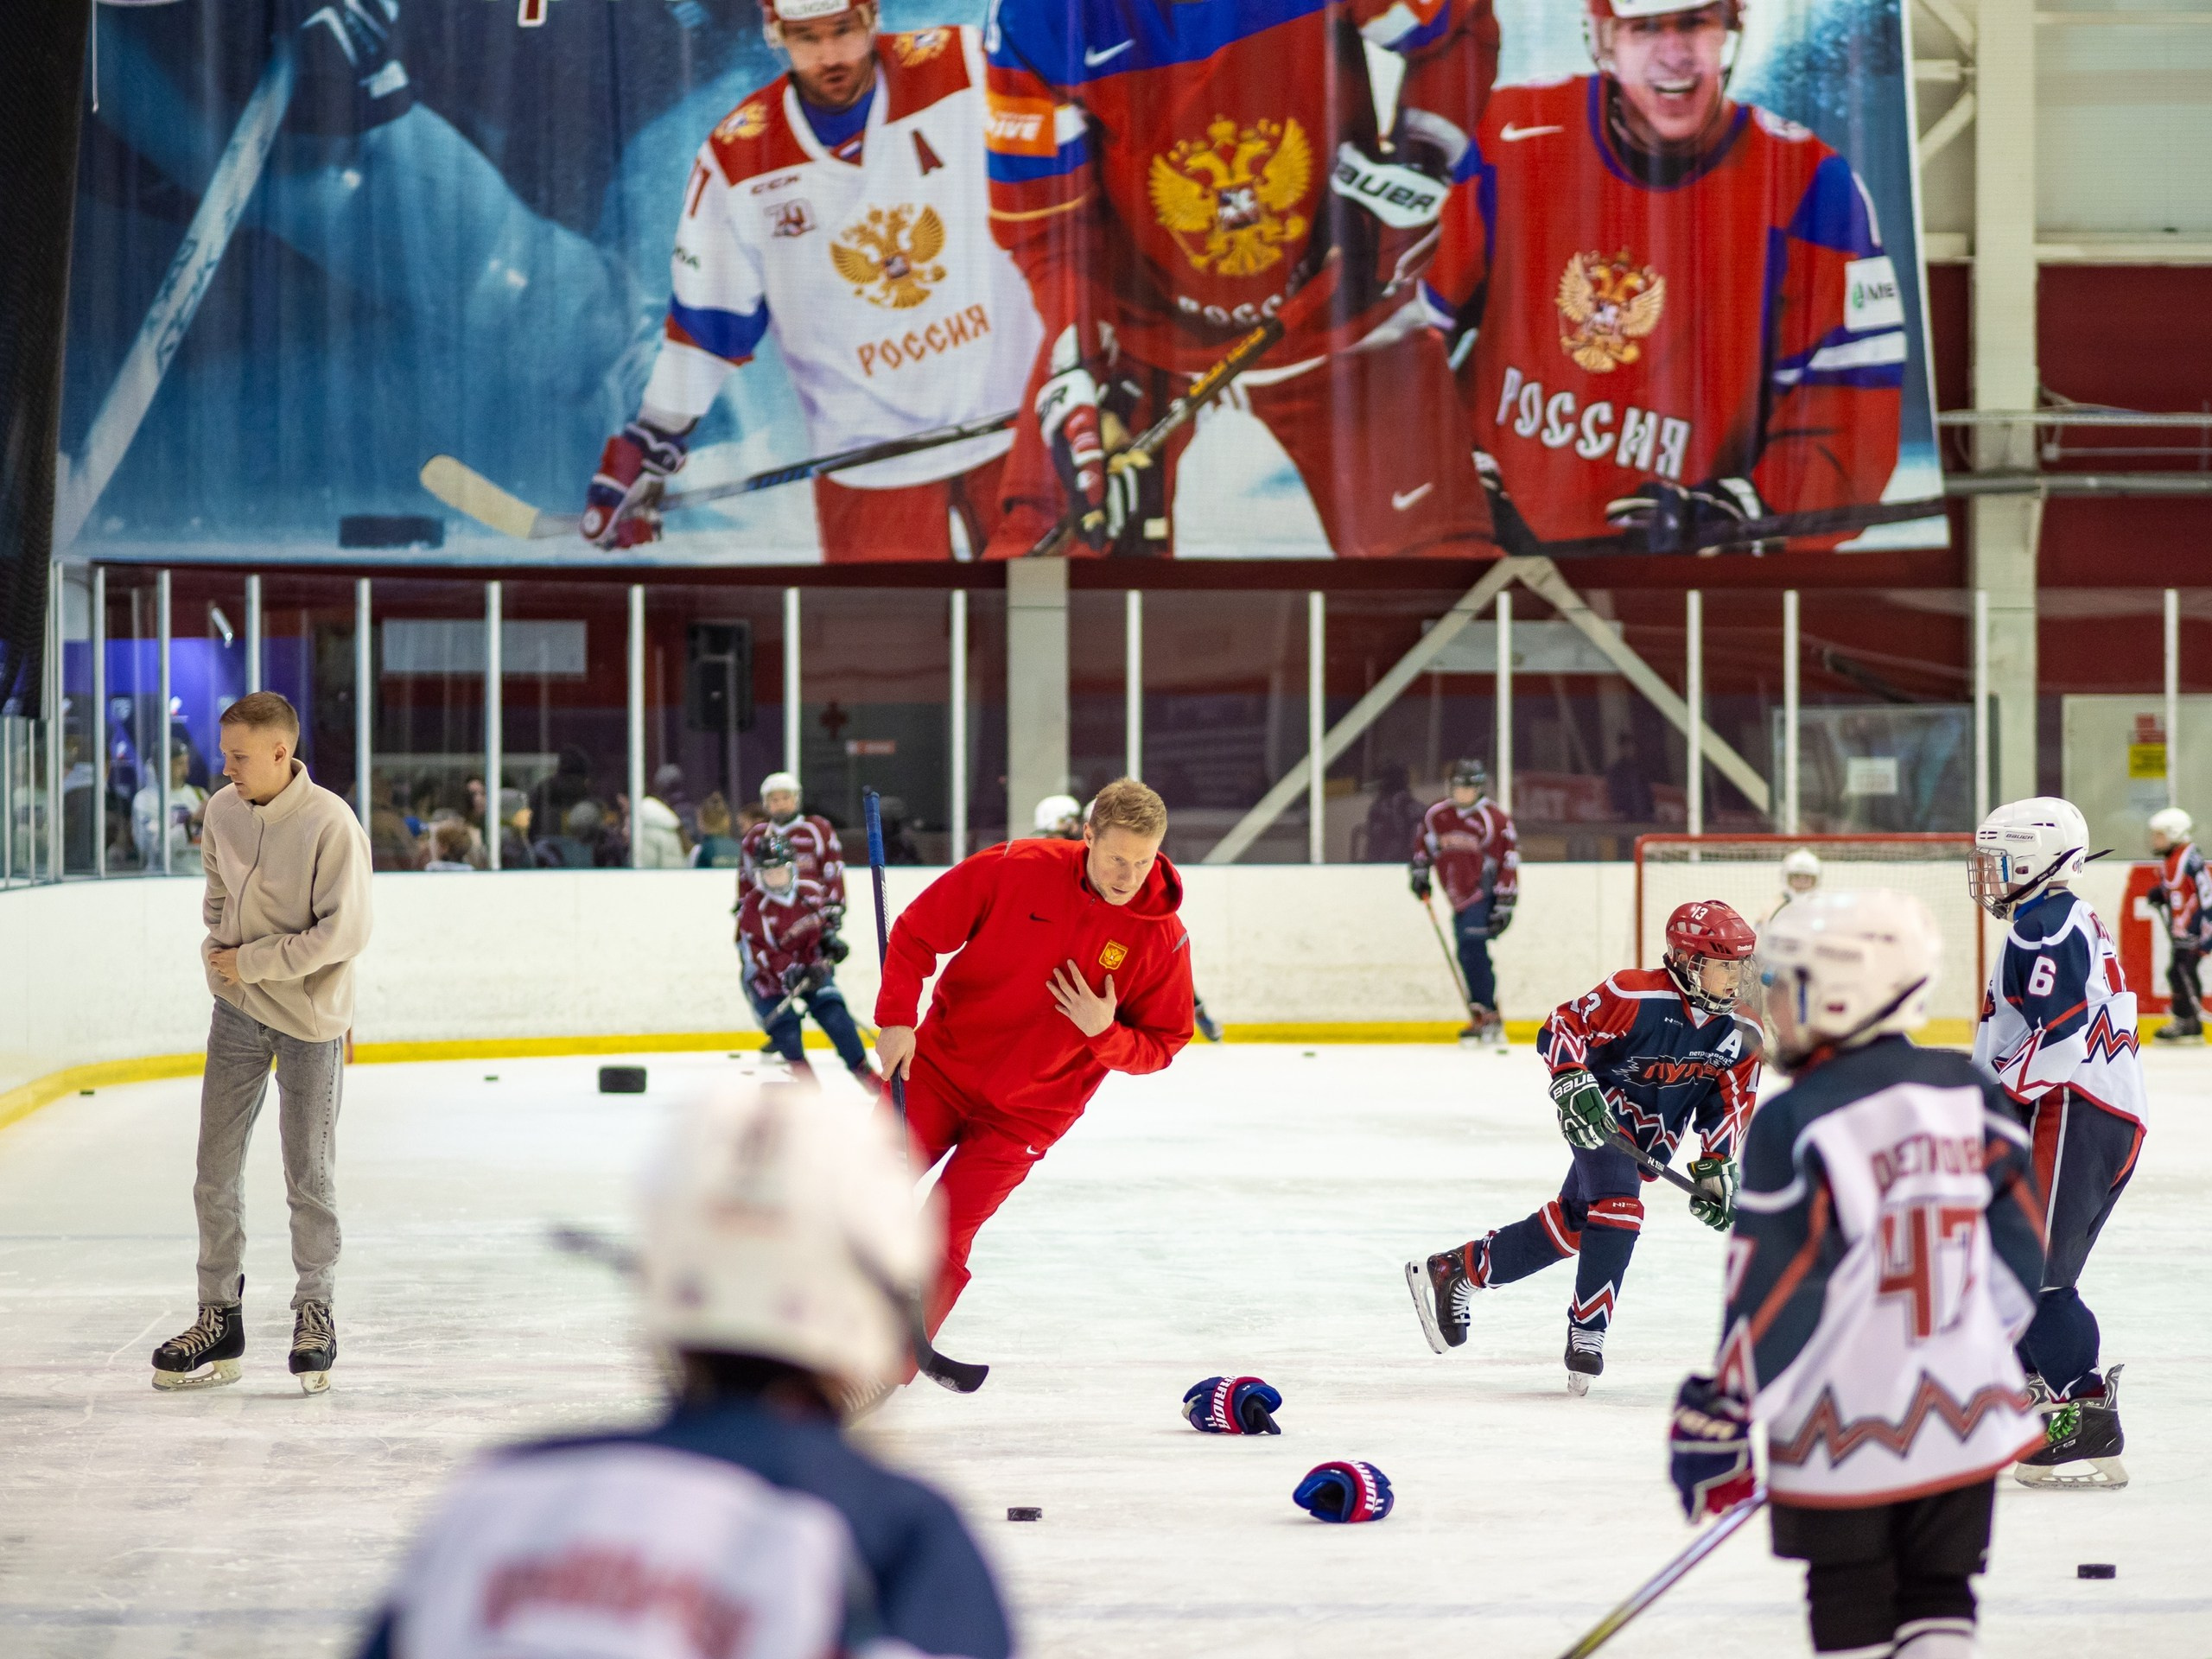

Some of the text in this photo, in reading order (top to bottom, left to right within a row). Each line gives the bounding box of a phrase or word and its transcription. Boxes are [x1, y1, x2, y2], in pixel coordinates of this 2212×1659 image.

[1337, 162, 1437, 214] AUER
[857, 303, 991, 378] РОССИЯ
[1496, 366, 1692, 480] РОССИЯ
[1691, 905, 1709, 921] 13
[2028, 955, 2056, 997] 6
[1716, 1028, 1744, 1059] A
[1553, 1073, 1598, 1100] BAUE
[1875, 1203, 1980, 1341] 47
